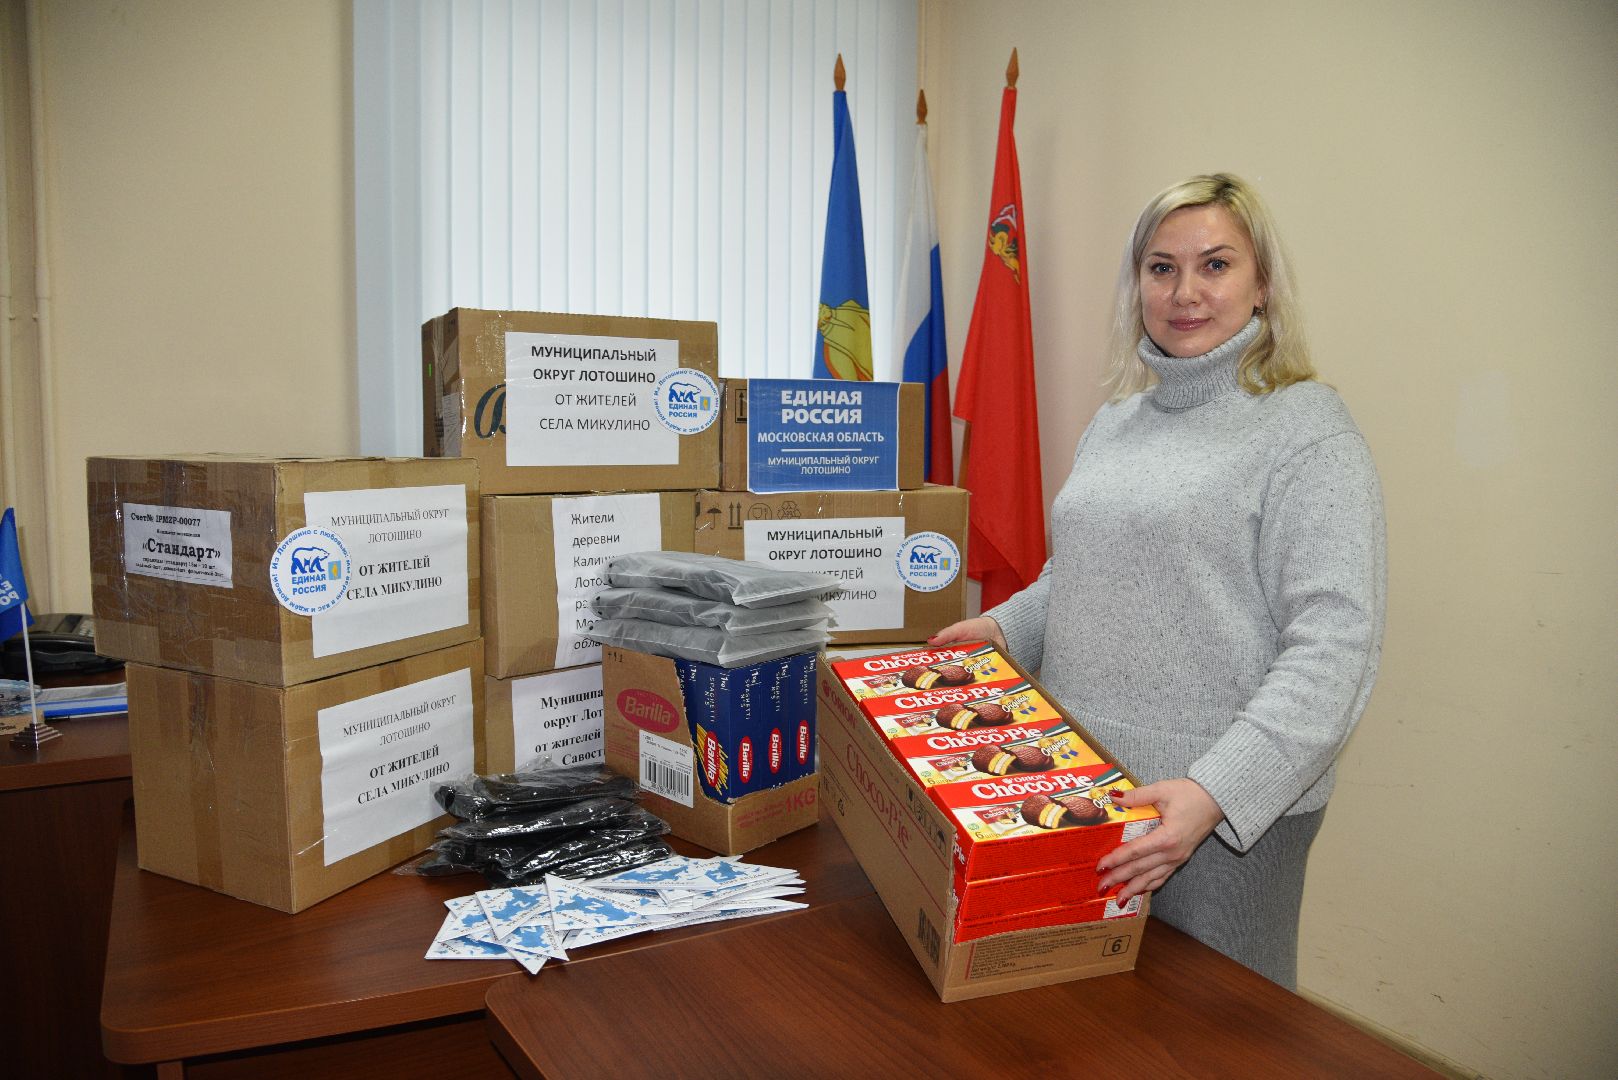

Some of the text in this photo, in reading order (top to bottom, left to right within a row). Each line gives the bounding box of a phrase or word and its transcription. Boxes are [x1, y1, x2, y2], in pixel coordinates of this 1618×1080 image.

[531, 346, 656, 362] МУНИЦИПАЛЬНЫЙ
[533, 368, 656, 384] ОКРУГ ЛОТОШИНО
[555, 392, 636, 407] ОТ ЖИТЕЛЕЙ
[781, 390, 862, 406] ЕДИНАЯ
[782, 408, 862, 424] РОССИЯ
[539, 418, 650, 431] СЕЛА МИКУЛИНО
[758, 432, 884, 443] МОСКОВСКАЯ ОБЛАСТЬ
[768, 456, 880, 466] МУНИЦИПАЛЬНЫЙ ОКРУГ
[800, 466, 850, 475] ЛОТОШИНО
[331, 508, 450, 526] МУНИЦИПАЛЬНЫЙ ОКРУГ
[571, 513, 615, 526] Жители
[368, 530, 422, 544] ЛОТОШИНО
[572, 534, 620, 548] деревни
[767, 526, 882, 542] МУНИЦИПАЛЬНЫЙ
[142, 538, 220, 562] «Стандарт»
[277, 530, 312, 555] Лотошино
[769, 548, 882, 560] ОКРУГ ЛОТОШИНО
[358, 555, 430, 576] ОТ ЖИТЕЛЕЙ
[292, 574, 326, 586] ЕДИНАЯ
[346, 576, 442, 600] СЕЛА МИКУЛИНО
[575, 576, 607, 588] Лото
[292, 584, 326, 596] РОССИЯ
[964, 658, 990, 674] Original
[933, 688, 963, 696] ORION
[625, 696, 672, 725] Barilla
[1002, 694, 1030, 713] Original
[344, 695, 456, 738] МУНИЦИПАЛЬНЫЙ ОКРУГ
[544, 709, 604, 730] округ Лот
[380, 722, 430, 746] ЛОТОШИНО
[535, 743, 548, 753] от
[552, 729, 601, 750] жителей
[772, 734, 780, 768] Barilla
[1041, 738, 1070, 756] Original
[370, 744, 440, 778] ОТ ЖИТЕЛЕЙ
[562, 748, 606, 766] Савост
[708, 736, 716, 783] Barilla
[742, 742, 750, 778] Barilla
[358, 762, 450, 805] СЕЛА МИКУЛИНО
[1014, 774, 1046, 784] ORION
[976, 832, 984, 840] 6
[1112, 938, 1122, 952] 6
